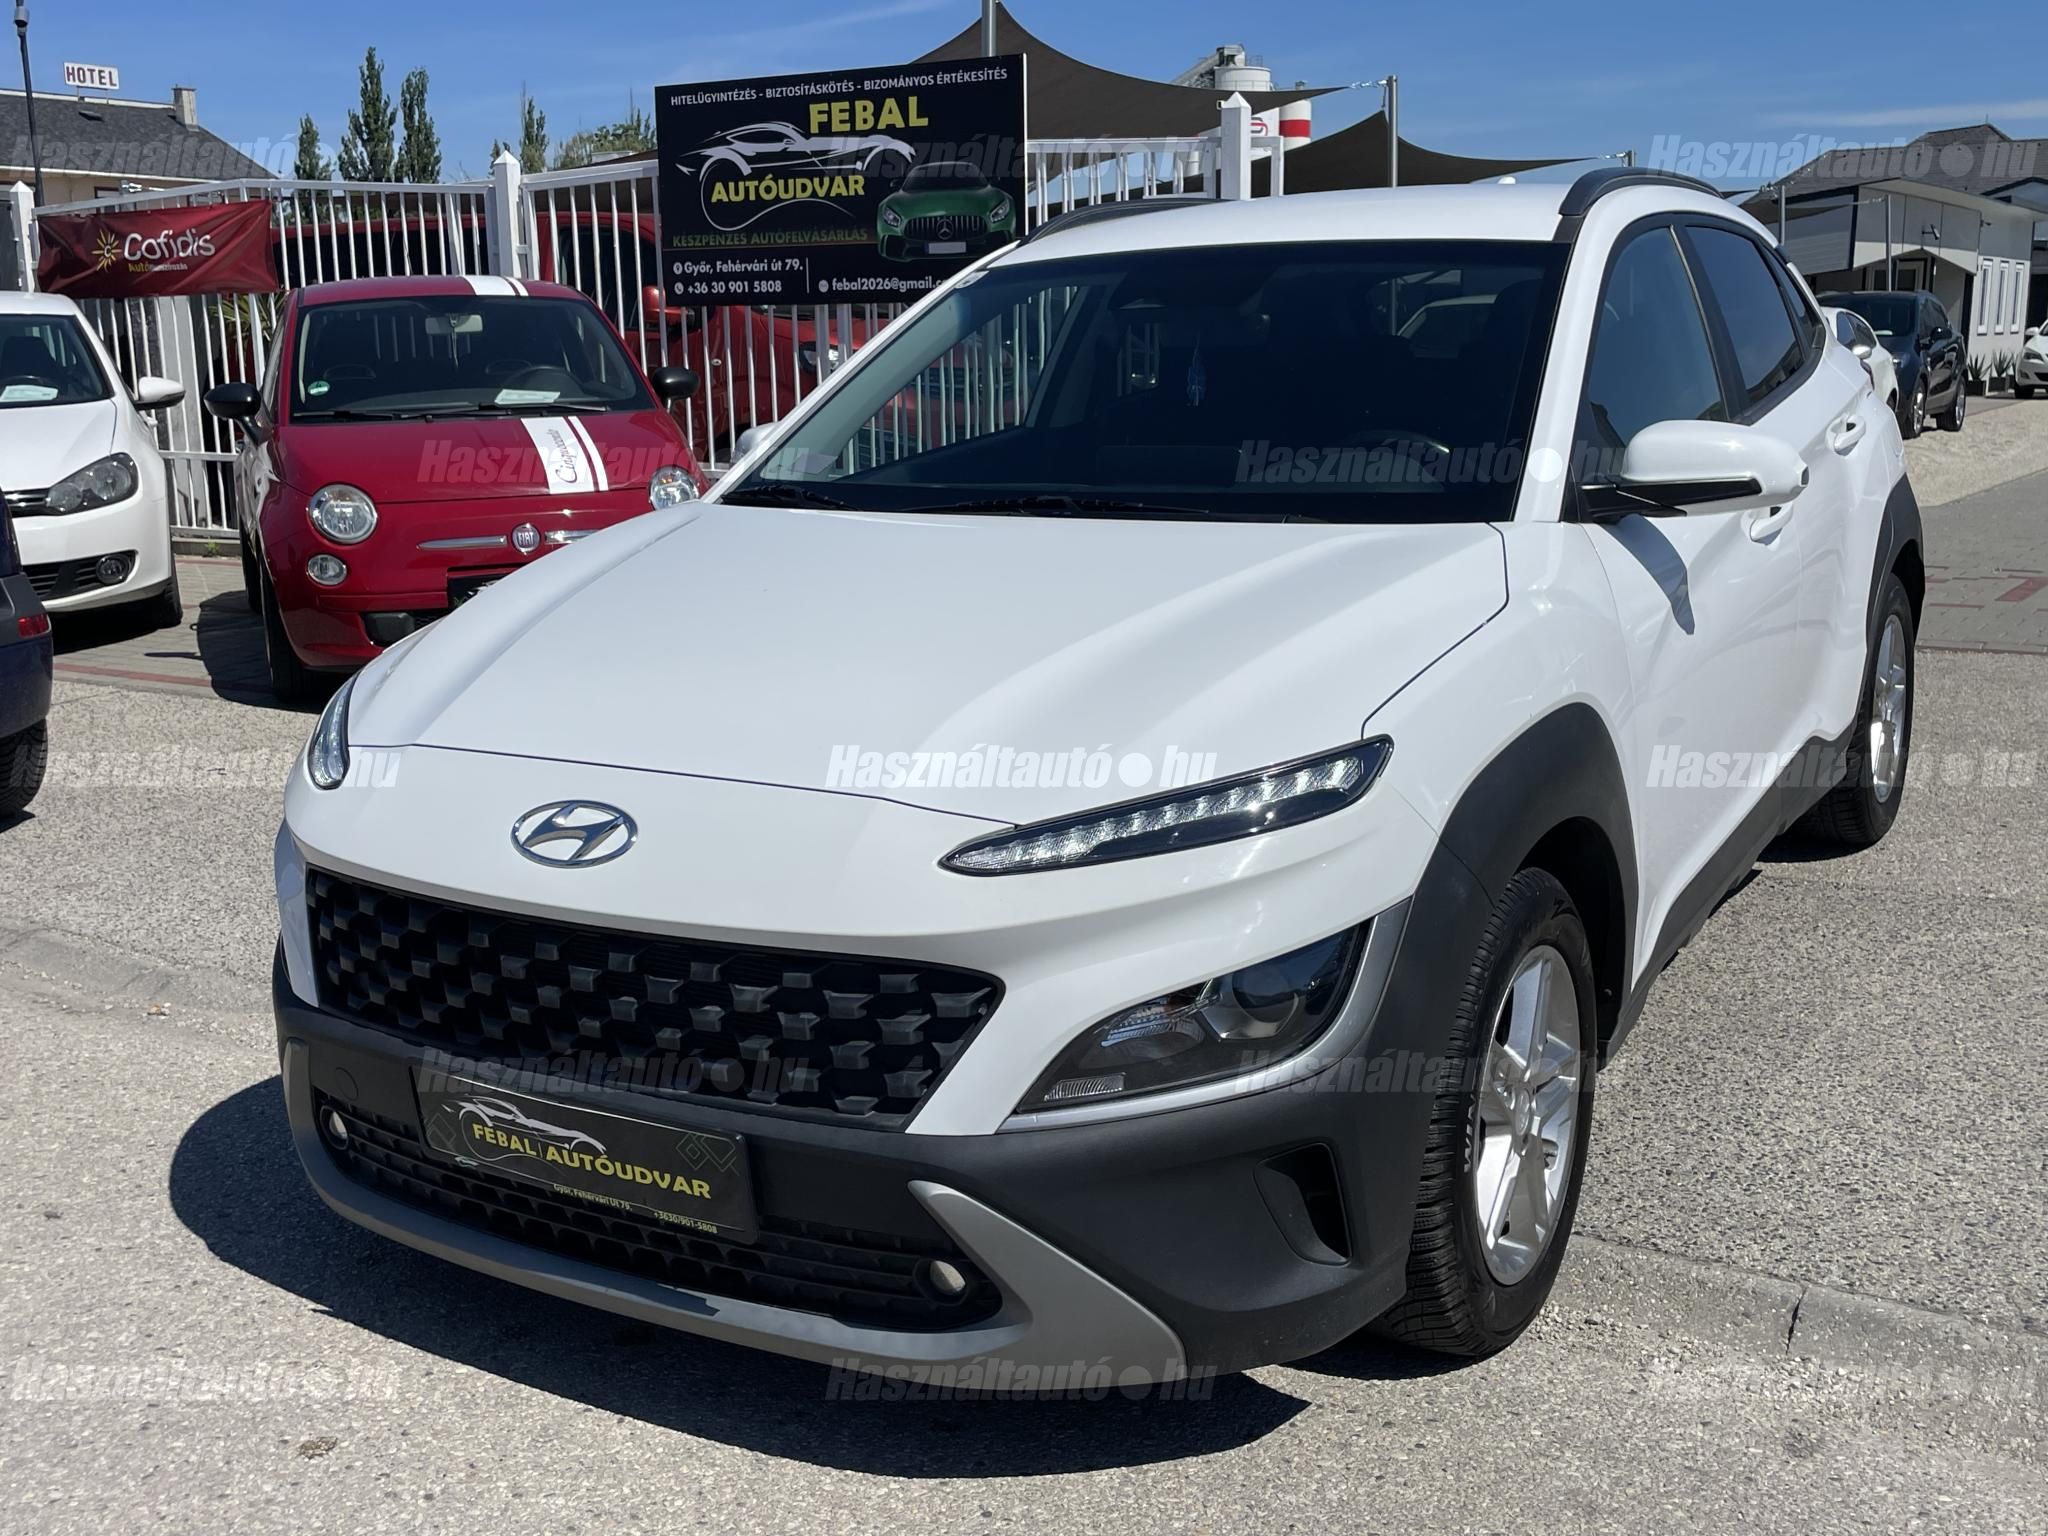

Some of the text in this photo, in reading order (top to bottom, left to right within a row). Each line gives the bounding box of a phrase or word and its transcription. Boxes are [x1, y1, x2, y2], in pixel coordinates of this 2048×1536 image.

[66, 66, 117, 87] HOTEL
[671, 88, 757, 106] HITELÜGYINTÉZÉS
[765, 80, 854, 98] BIZTOSÍTÁSKÖTÉS
[864, 75, 934, 91] BIZOMÁNYOS
[936, 67, 1008, 85] ÉRTÉKESÍTÉS
[809, 96, 929, 134] FEBAL
[711, 173, 865, 203] AUTÓUDVAR
[124, 228, 216, 260] Cofidis
[684, 258, 803, 276] Győr, Fehérvári út 79.
[688, 280, 782, 294] +36 30 901 5808
[832, 275, 948, 292] febal2026@gmail.c
[518, 531, 534, 545] FIAT
[472, 1123, 711, 1199] FEBAL AUTÓUDVAR
